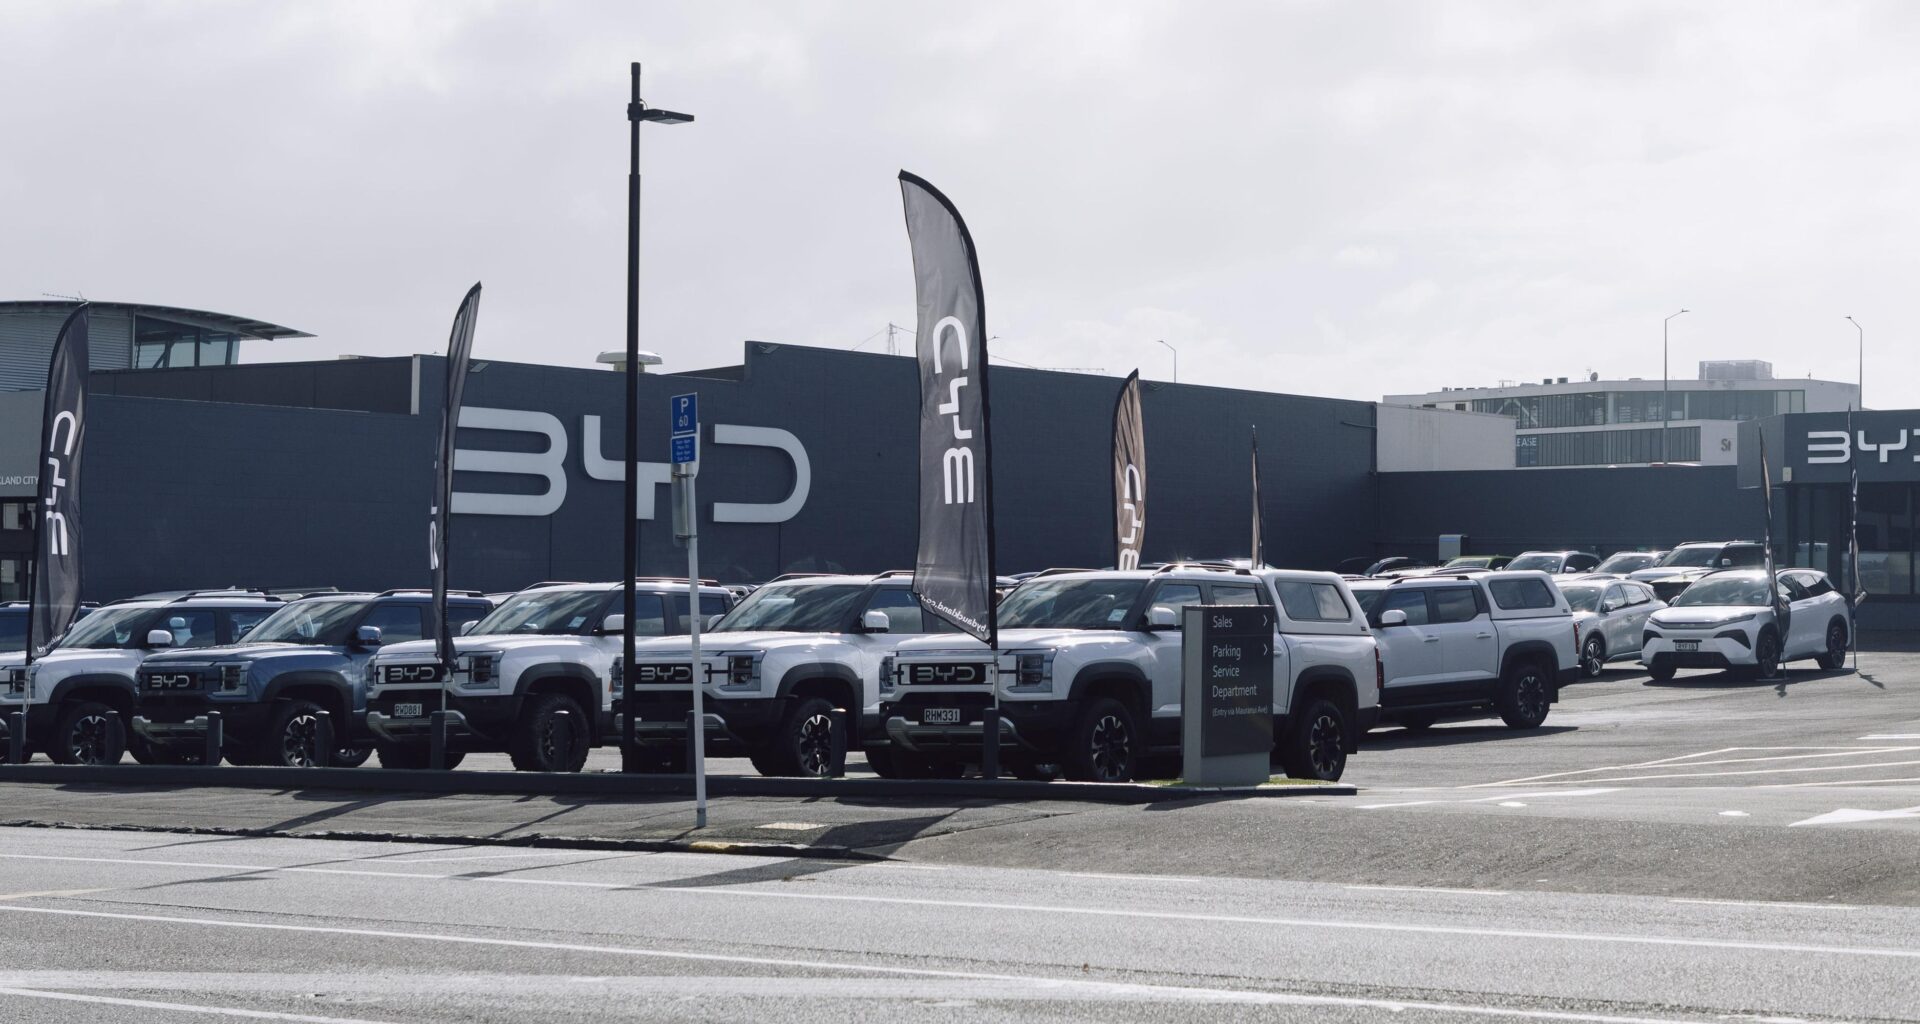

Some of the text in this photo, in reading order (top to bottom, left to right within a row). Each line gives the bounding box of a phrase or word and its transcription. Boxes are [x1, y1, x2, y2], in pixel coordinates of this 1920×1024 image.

[681, 398, 689, 413] P
[679, 415, 689, 427] 60
[1808, 429, 1920, 463] BY
[451, 406, 811, 522] BYD
[0, 476, 22, 485] LAND
[46, 411, 76, 555] BYD
[1212, 615, 1233, 628] Sales
[1212, 645, 1241, 661] Parking
[391, 667, 435, 681] BYD
[641, 667, 691, 681] BYD
[917, 666, 975, 681] BYD
[1212, 665, 1240, 678] Service
[152, 675, 190, 688] BYD
[1212, 685, 1257, 700] Department
[926, 710, 959, 722] RHM331
